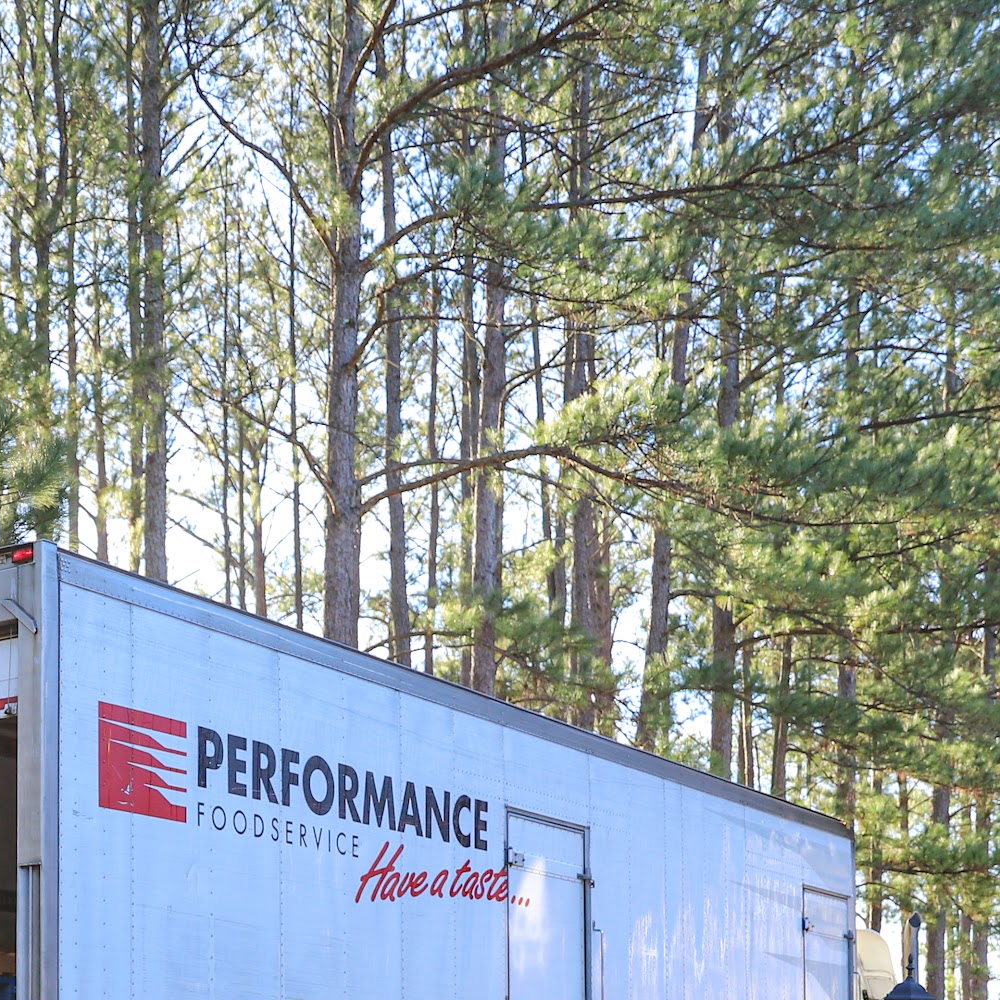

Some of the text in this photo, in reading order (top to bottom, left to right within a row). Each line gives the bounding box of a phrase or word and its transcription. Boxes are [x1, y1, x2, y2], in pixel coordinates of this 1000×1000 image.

[197, 725, 488, 851] PERFORMANCE
[197, 802, 359, 858] FOODSERVICE
[354, 841, 429, 904] Have
[430, 869, 449, 899] a
